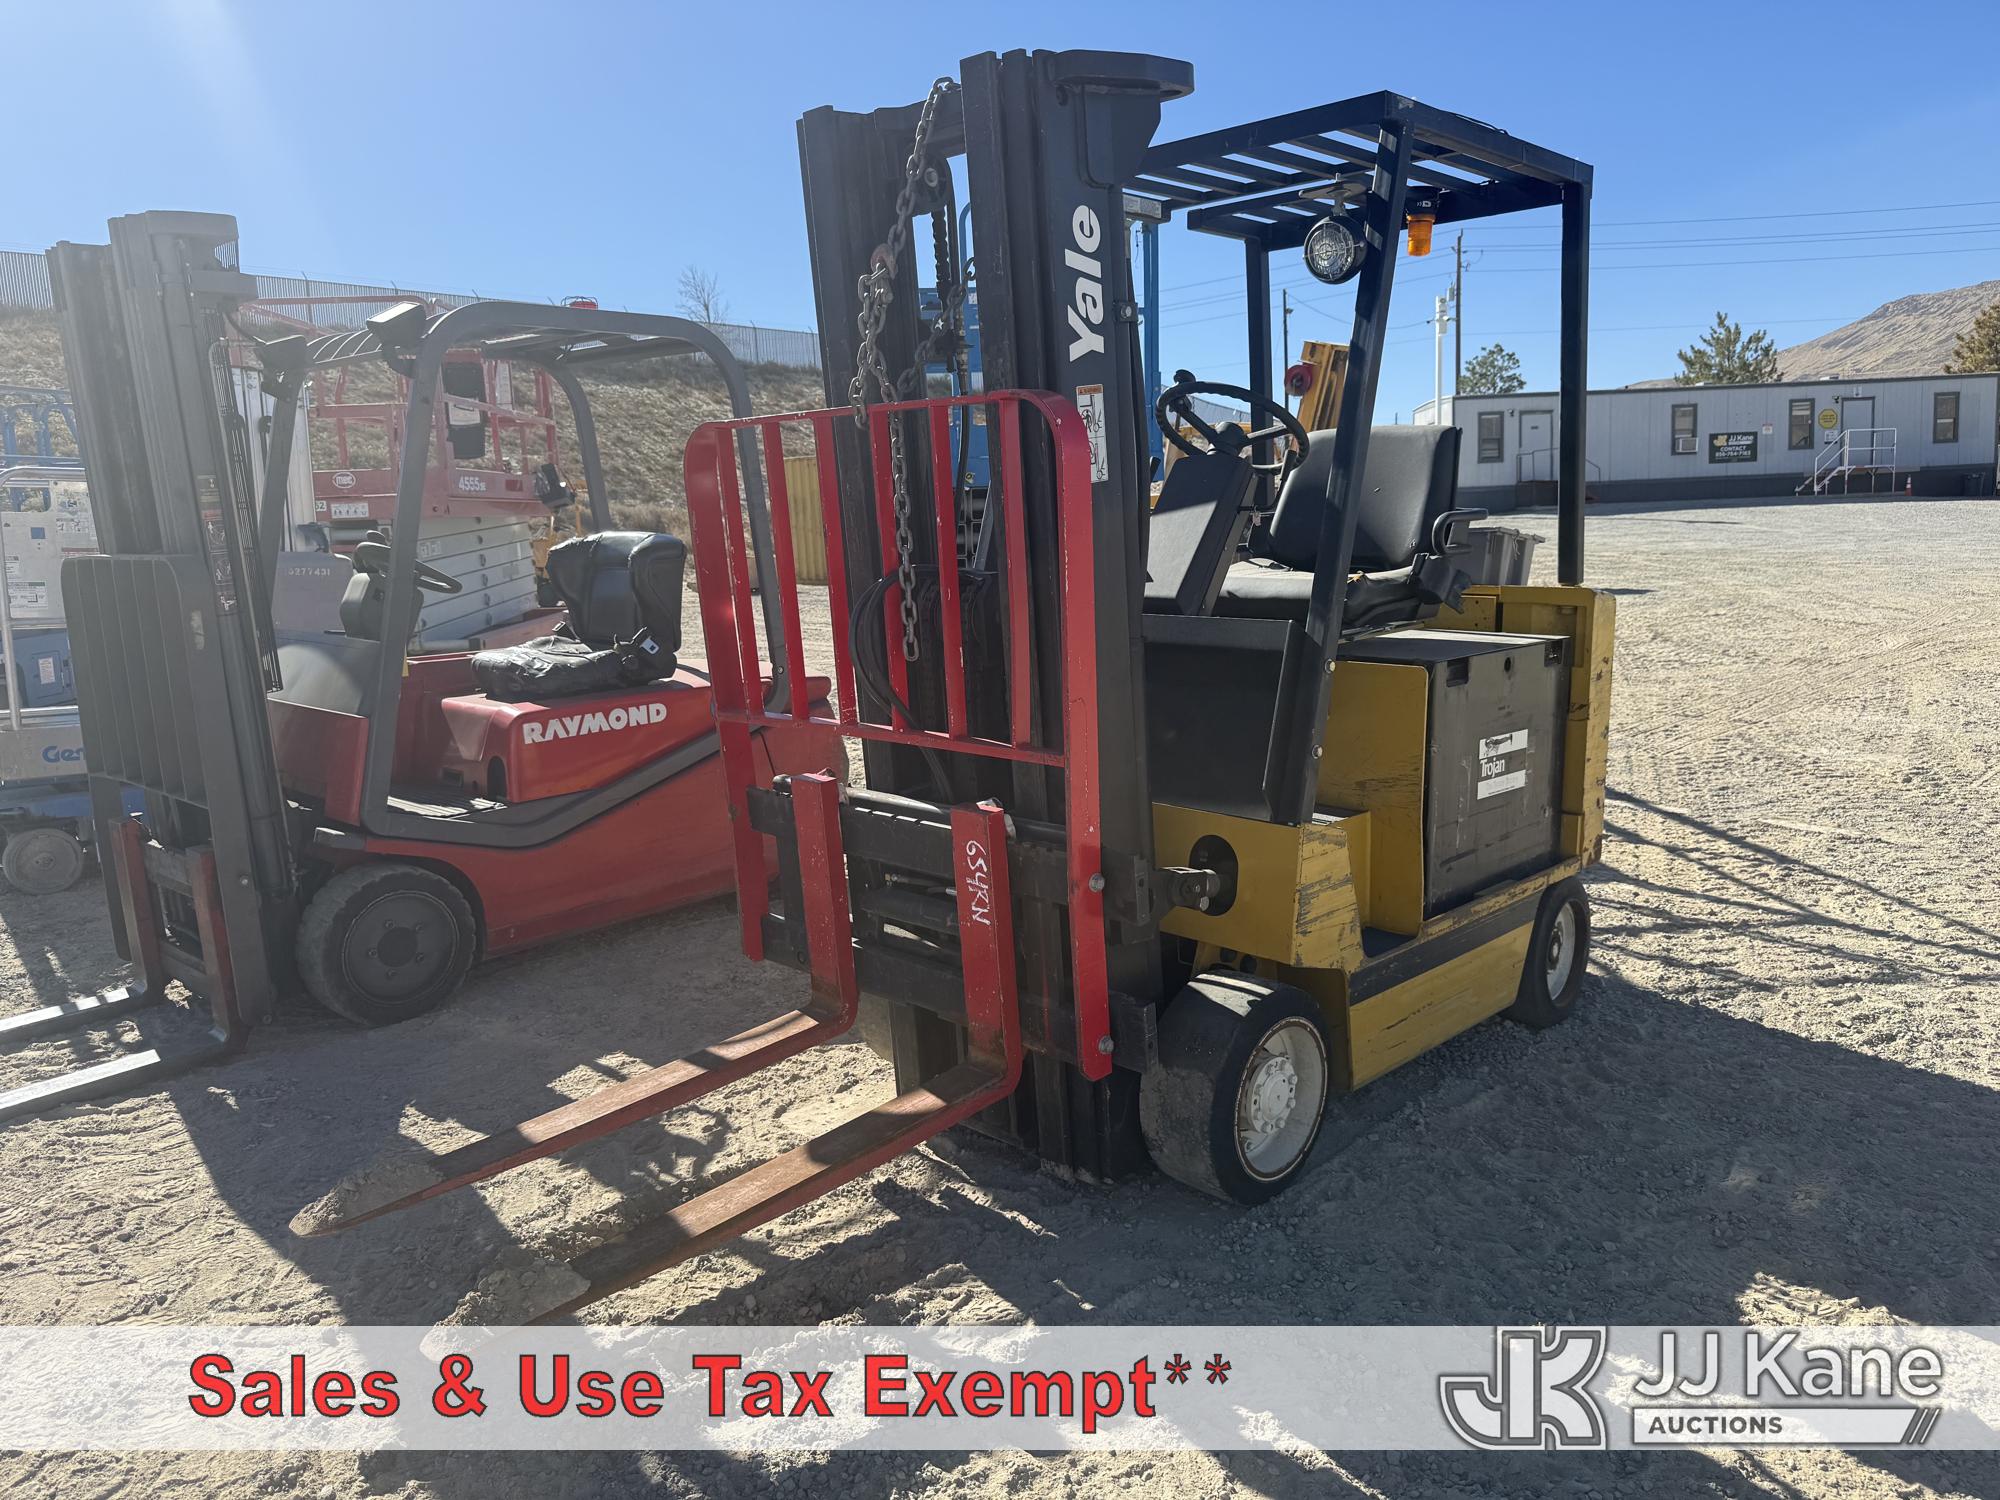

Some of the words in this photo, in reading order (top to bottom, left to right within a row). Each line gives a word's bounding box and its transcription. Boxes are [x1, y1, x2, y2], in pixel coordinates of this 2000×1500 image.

[1064, 204, 1105, 362] Yale
[522, 702, 668, 745] RAYMOND
[1480, 757, 1505, 778] Trojan
